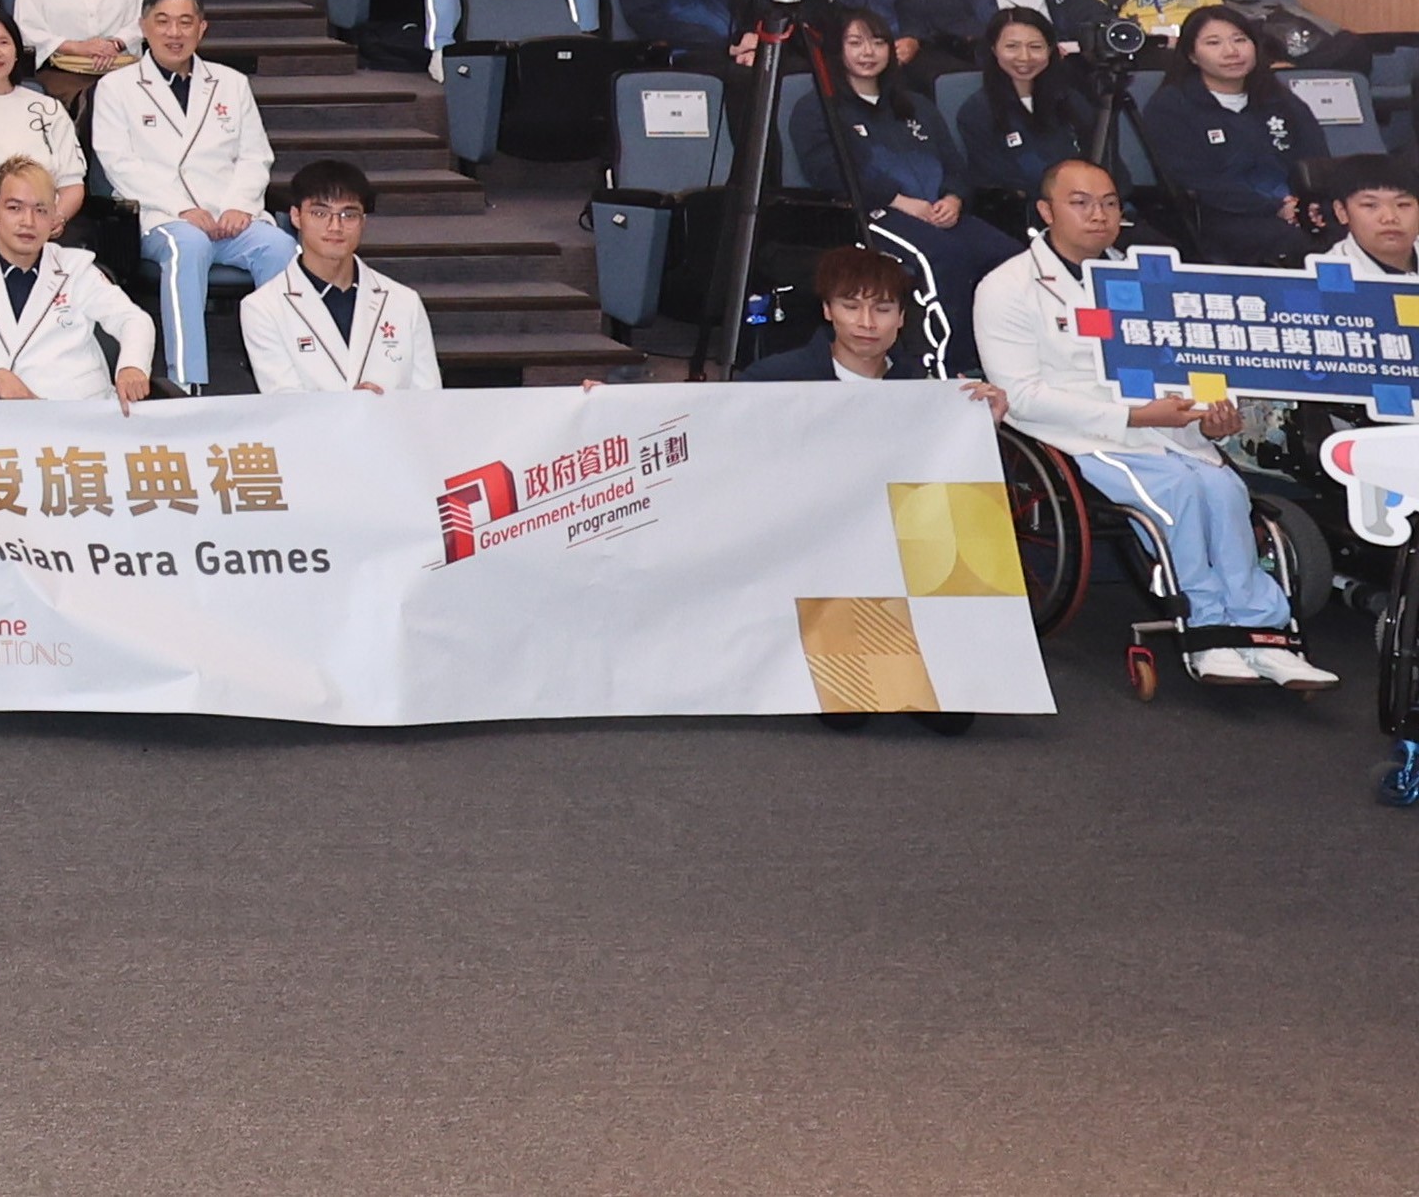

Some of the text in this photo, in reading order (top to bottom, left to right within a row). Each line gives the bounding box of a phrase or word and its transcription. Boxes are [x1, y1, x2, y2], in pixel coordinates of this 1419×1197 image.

[1269, 311, 1375, 328] JOCKEY CLUB
[1174, 353, 1232, 366] ATHLETE
[1235, 355, 1312, 371] INCENTIVE
[1314, 361, 1377, 375] AWARDS
[479, 477, 636, 552] Government-funded
[566, 494, 652, 543] programme
[88, 543, 180, 577] Para
[194, 541, 332, 576] Games
